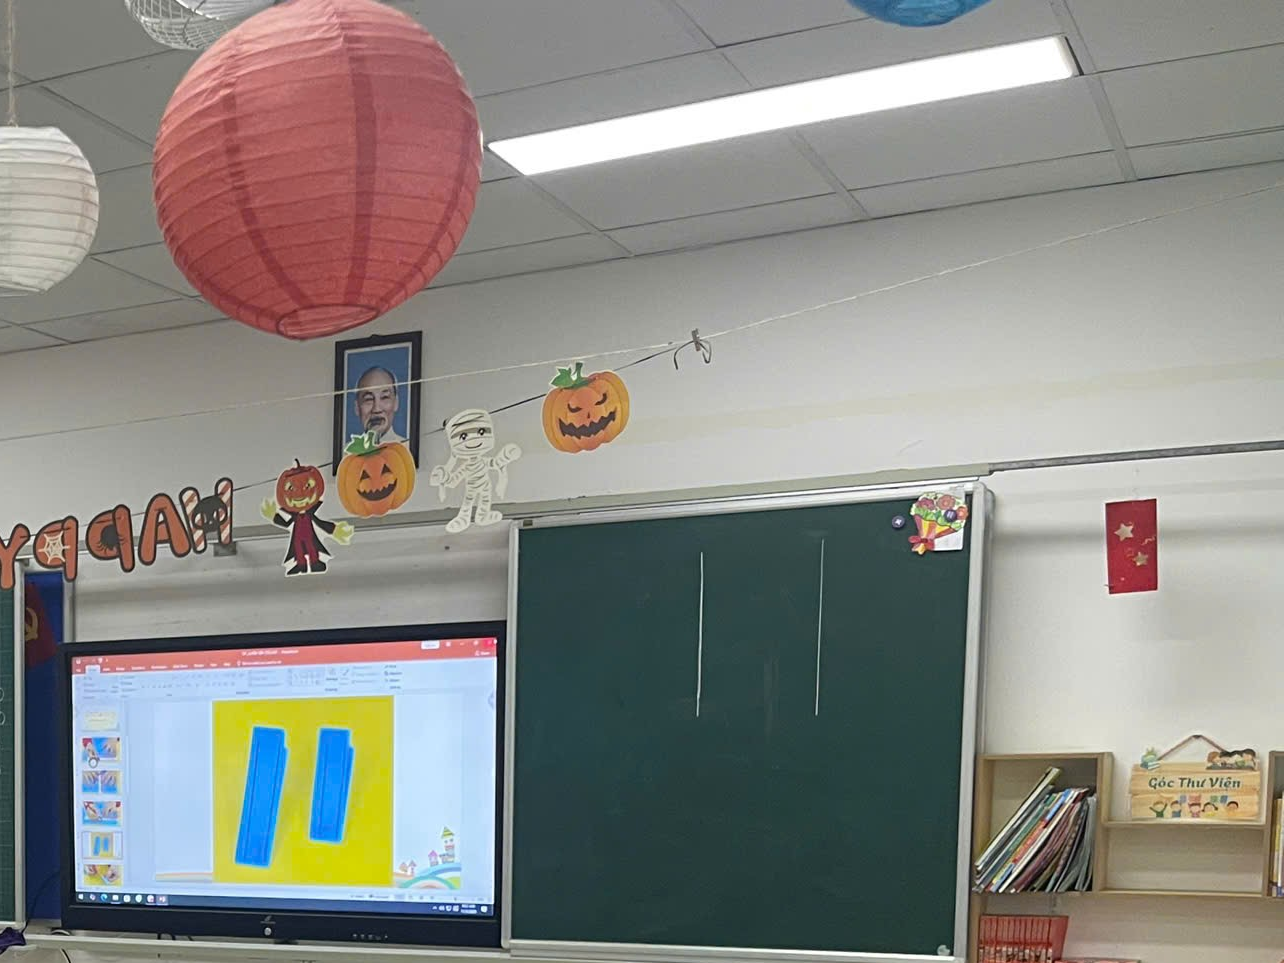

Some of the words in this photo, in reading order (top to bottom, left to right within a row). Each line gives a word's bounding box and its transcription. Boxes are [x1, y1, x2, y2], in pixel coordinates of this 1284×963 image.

[1148, 776, 1175, 790] Góc
[1178, 777, 1207, 789] Thư
[1209, 776, 1241, 791] Viện
